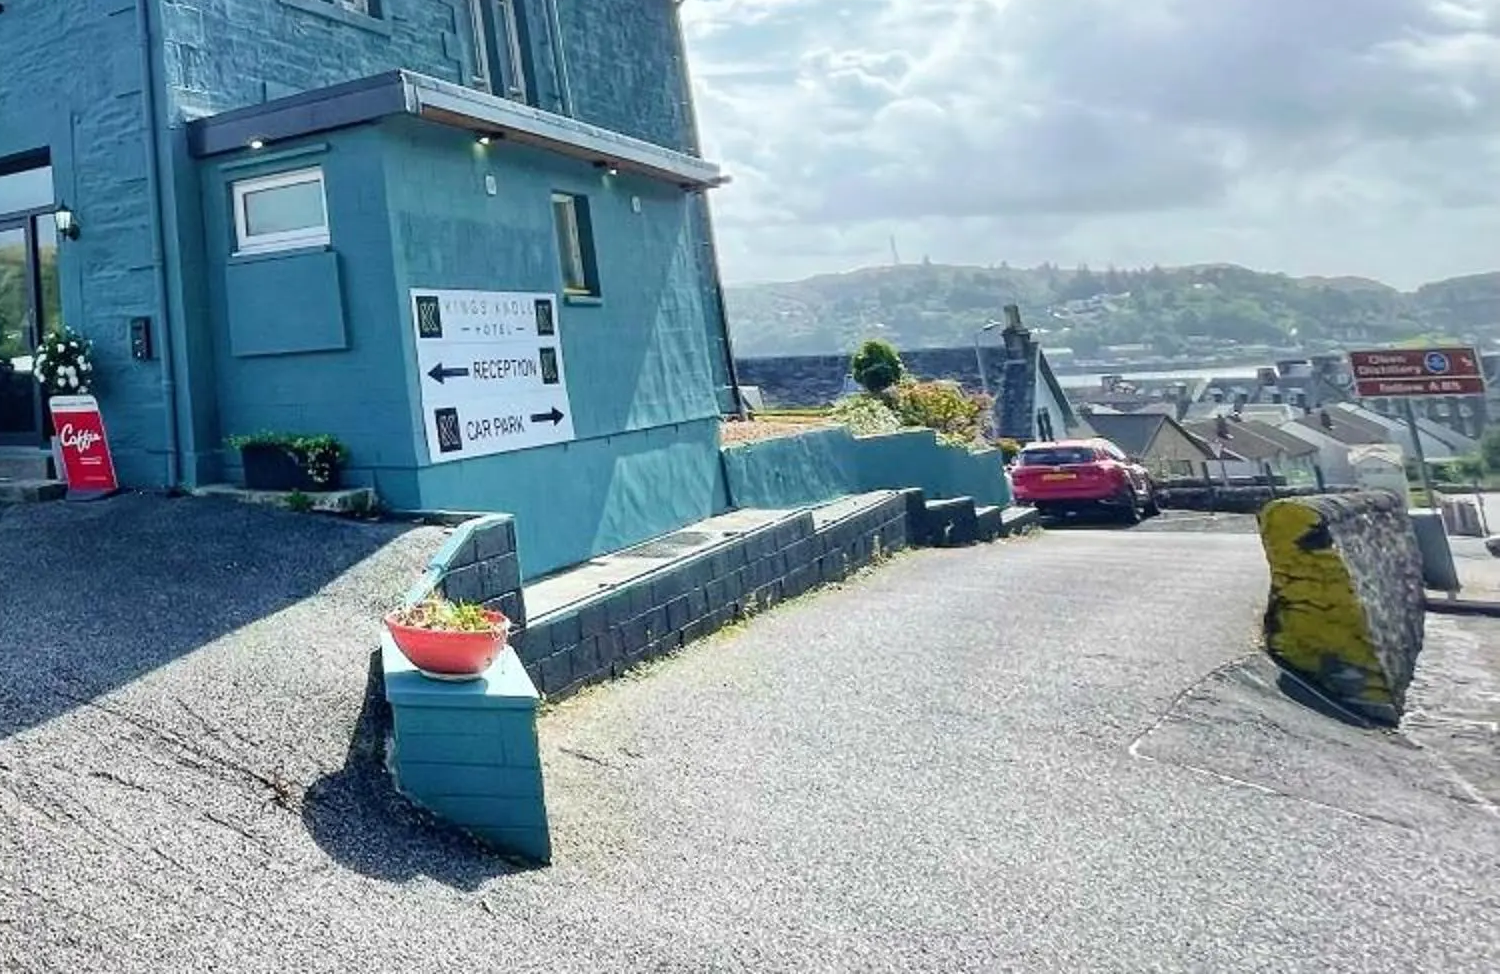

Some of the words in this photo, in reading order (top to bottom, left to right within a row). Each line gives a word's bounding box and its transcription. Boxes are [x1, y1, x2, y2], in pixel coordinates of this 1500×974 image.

[473, 359, 537, 380] RECEPTION
[467, 419, 491, 441] CAR
[495, 416, 526, 438] PARK
